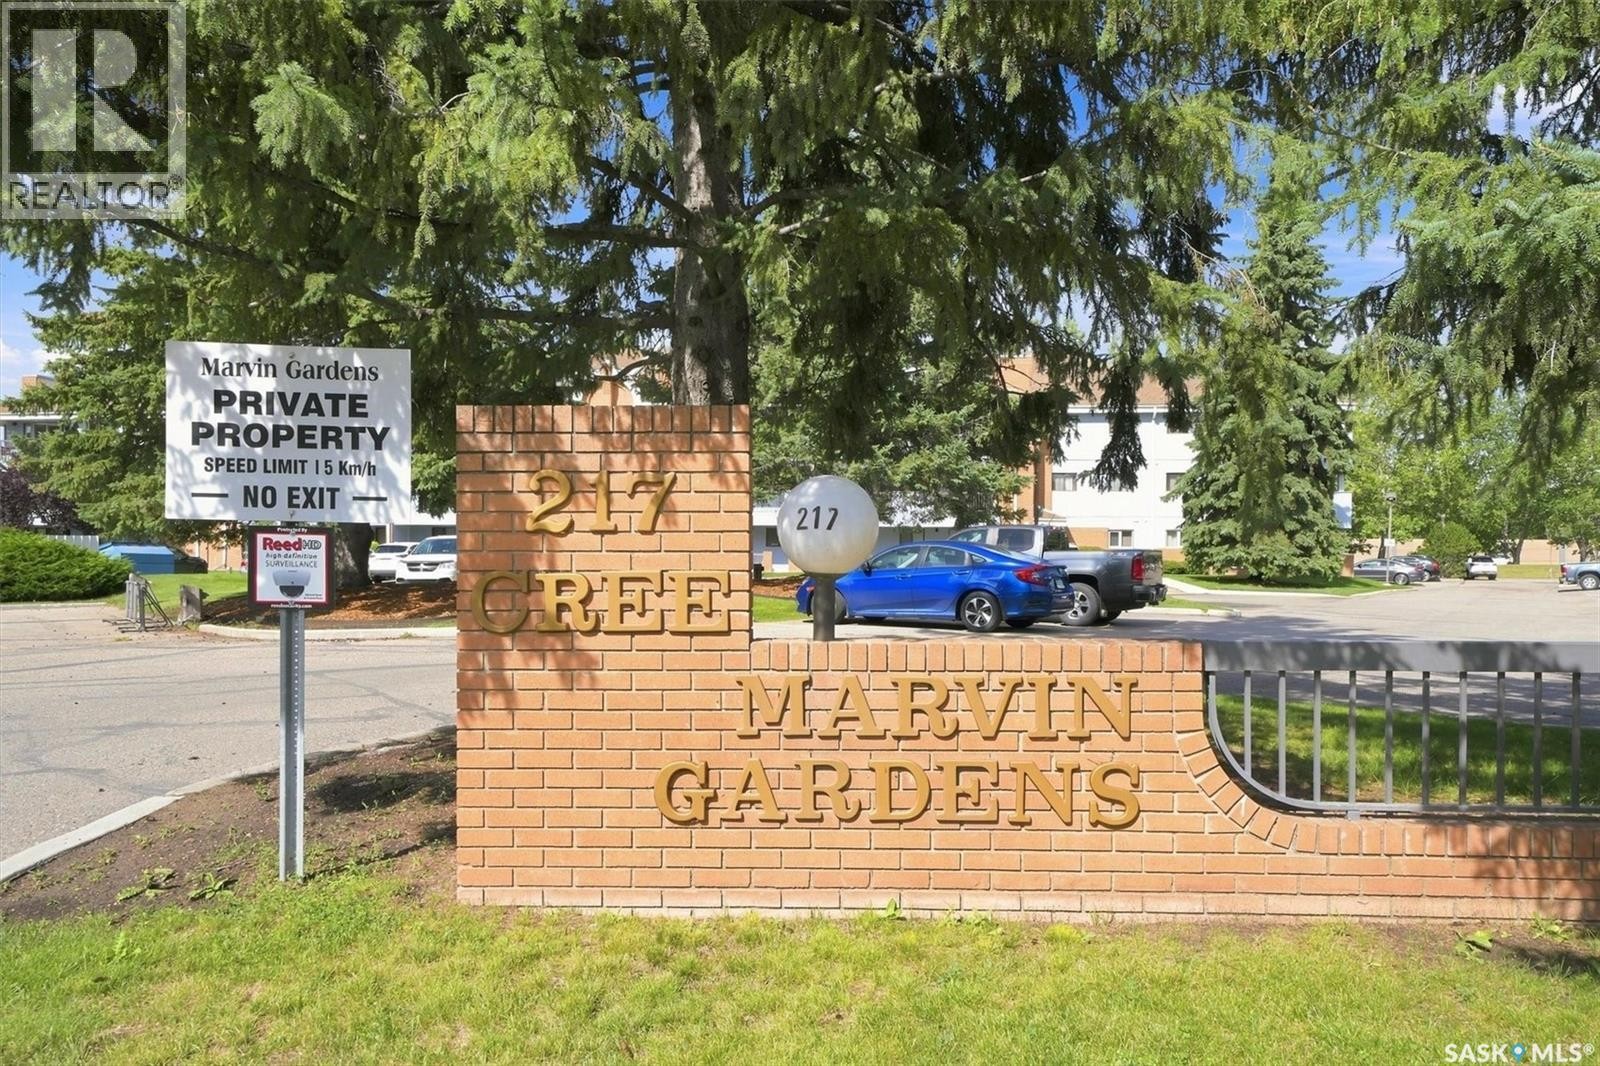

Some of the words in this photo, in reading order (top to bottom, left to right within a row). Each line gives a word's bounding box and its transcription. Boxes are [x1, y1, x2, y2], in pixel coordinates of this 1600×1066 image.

[201, 357, 278, 378] Marvin
[285, 360, 379, 382] Gardens
[213, 389, 369, 418] PRIVATE
[191, 421, 390, 451] PROPERTY
[204, 457, 257, 473] SPEED
[263, 459, 308, 475] LIMIT
[338, 461, 377, 477] Km/h
[243, 485, 277, 509] NO
[287, 486, 340, 510] EXIT
[525, 468, 677, 535] 217
[797, 506, 839, 530] 217
[265, 552, 282, 560] high
[283, 552, 318, 560] definition
[265, 560, 318, 568] SURVEILLANCE
[470, 570, 732, 634] CREE
[735, 674, 1139, 740] MARVIN
[652, 758, 1142, 828] GARDENS
